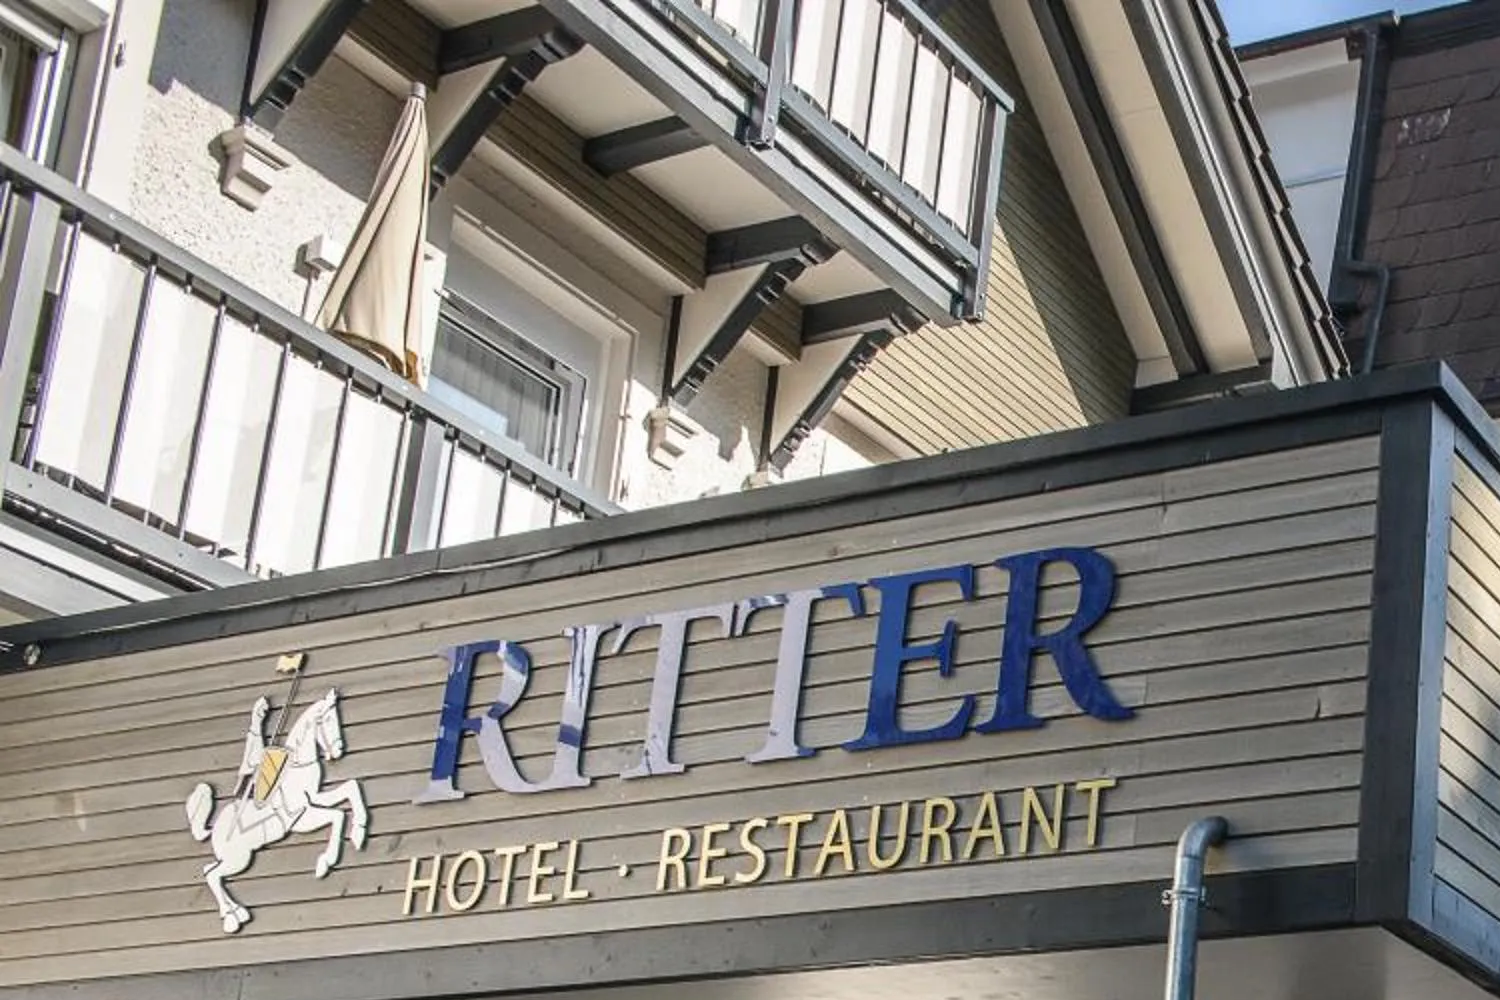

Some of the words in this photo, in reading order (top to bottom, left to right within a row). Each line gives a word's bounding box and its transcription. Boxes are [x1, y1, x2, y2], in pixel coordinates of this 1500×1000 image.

[412, 547, 1138, 804] RITTER
[402, 838, 590, 914] HOTEL
[655, 778, 1118, 891] RESTAURANT
